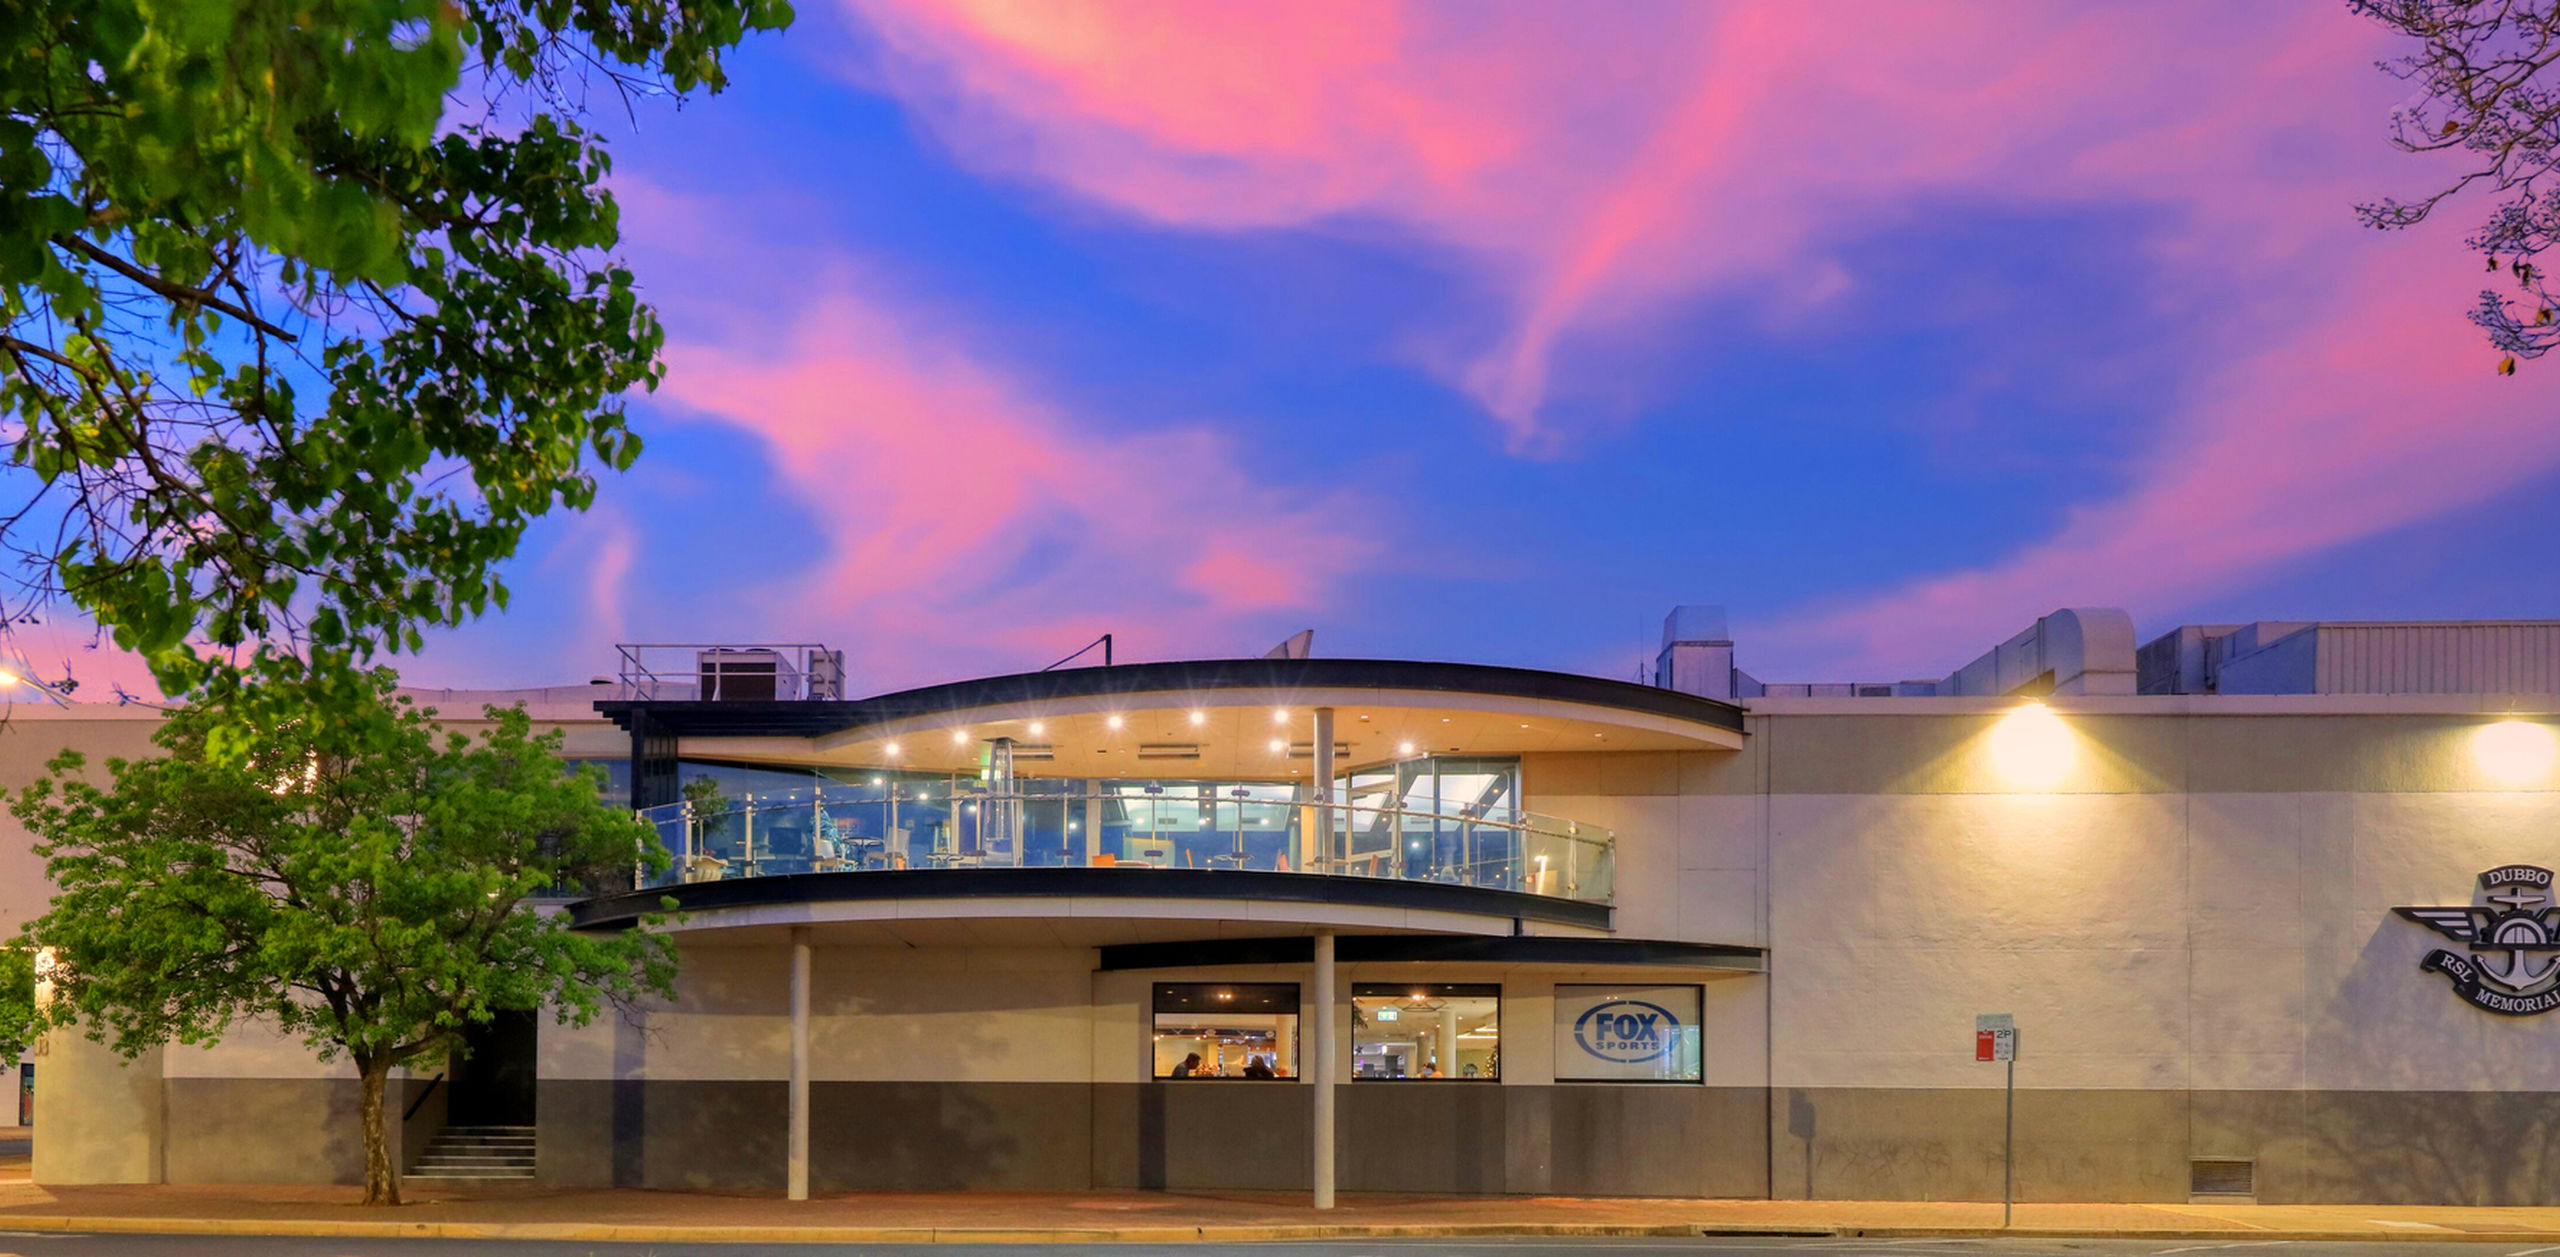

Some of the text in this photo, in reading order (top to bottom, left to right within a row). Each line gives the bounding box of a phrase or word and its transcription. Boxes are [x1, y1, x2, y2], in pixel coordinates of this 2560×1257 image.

[2488, 869, 2549, 885] DUBBO
[2440, 953, 2472, 983] RSL
[1596, 1013, 1659, 1041] FOX
[1996, 1030, 2012, 1039] 2P
[1595, 1041, 1660, 1050] SPORTS
